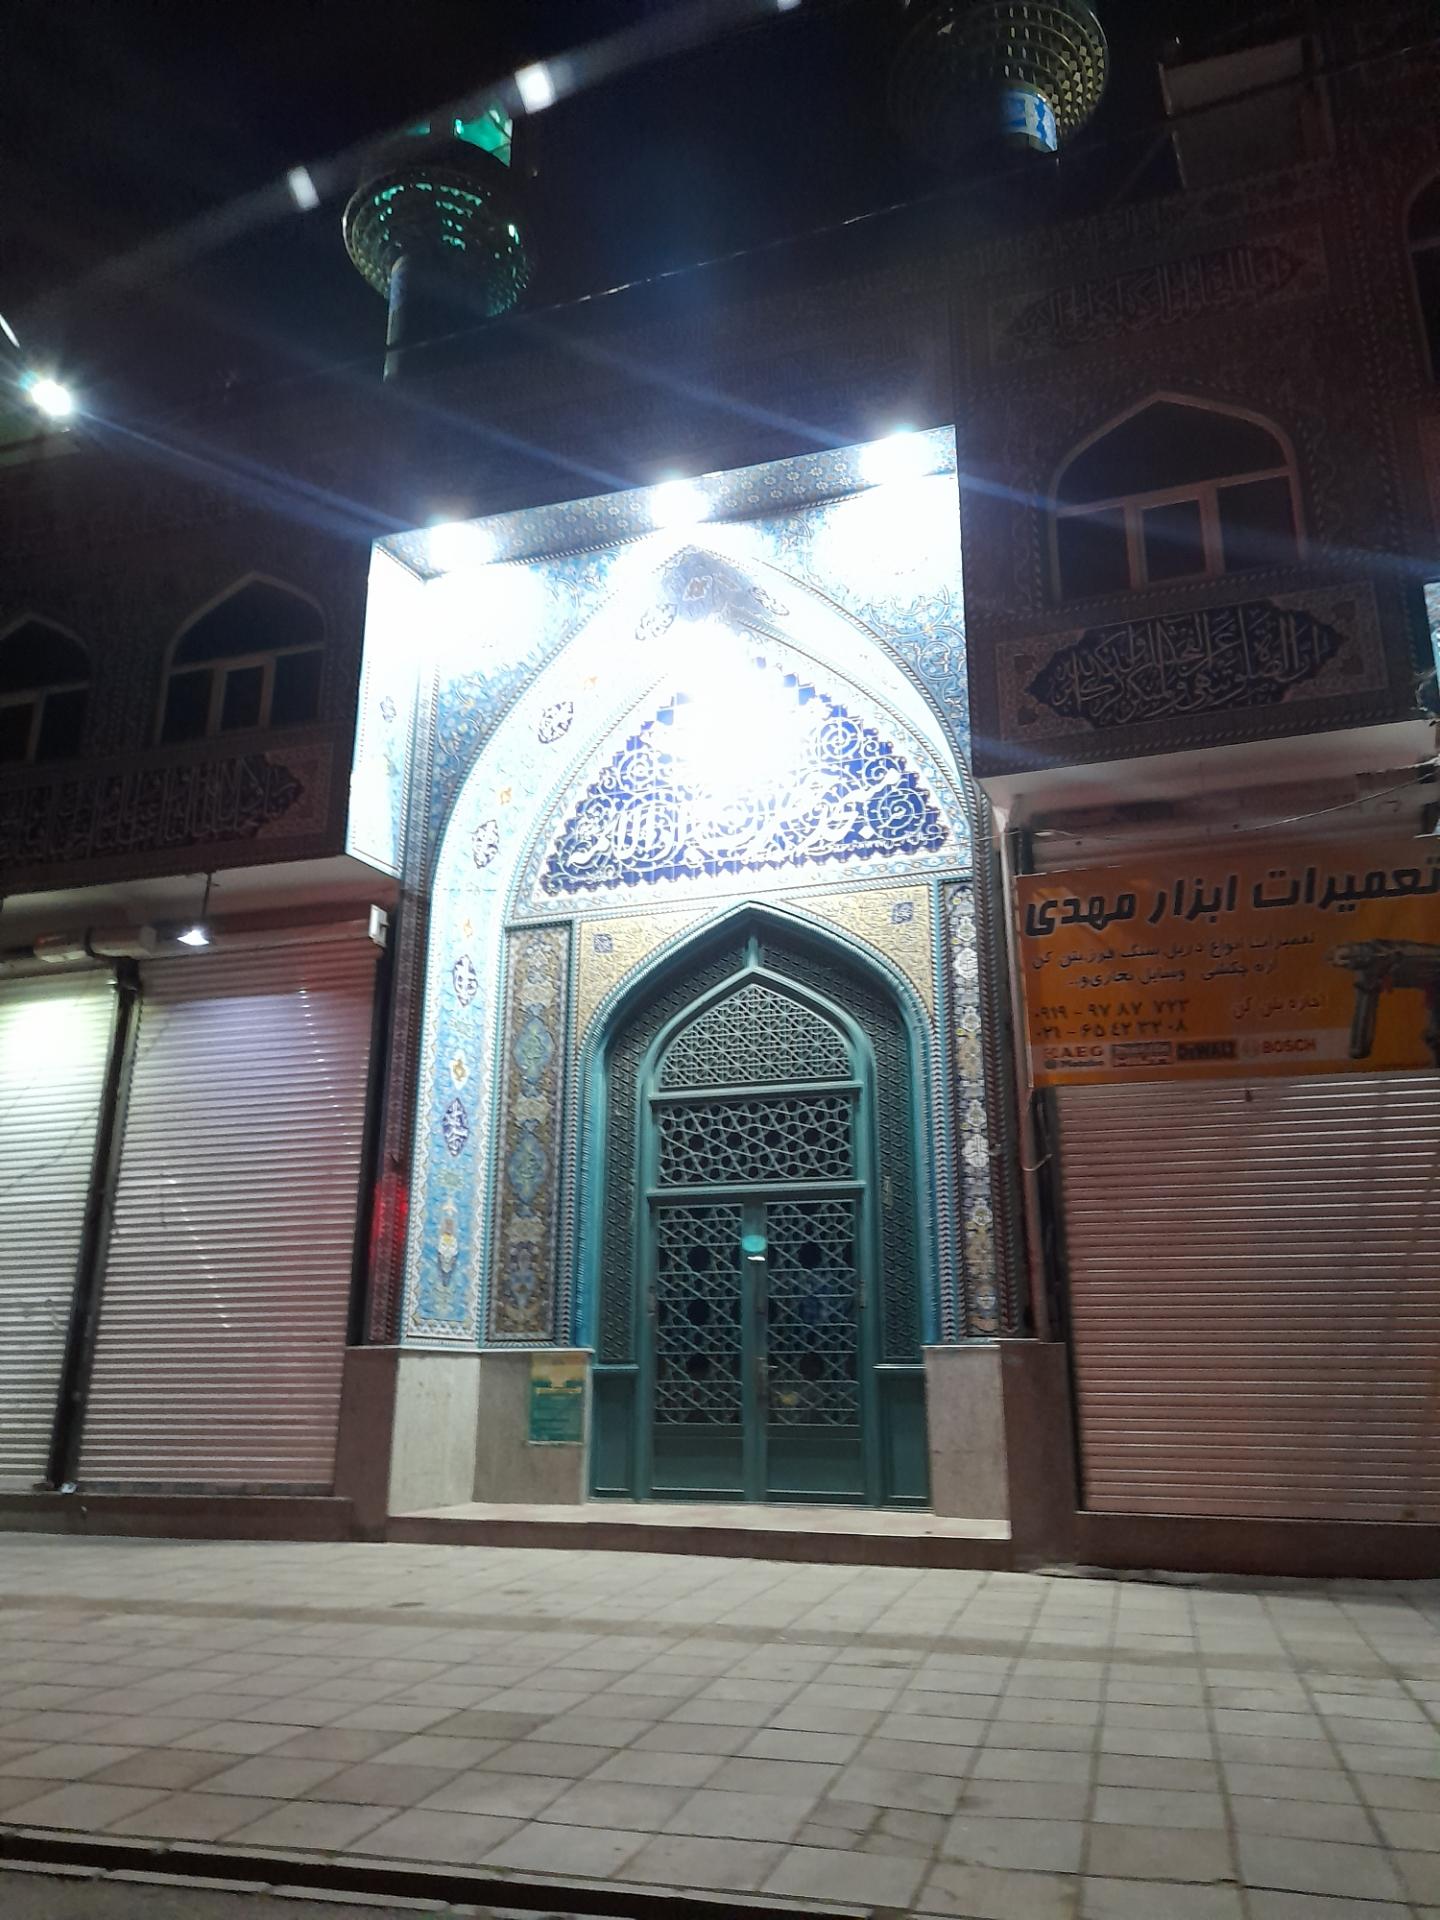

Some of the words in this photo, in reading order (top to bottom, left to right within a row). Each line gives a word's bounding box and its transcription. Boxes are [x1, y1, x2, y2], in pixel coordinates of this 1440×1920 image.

[1147, 874, 1239, 924] ابزار
[1062, 1045, 1105, 1058] AEG
[1262, 1038, 1317, 1054] BOSCH
